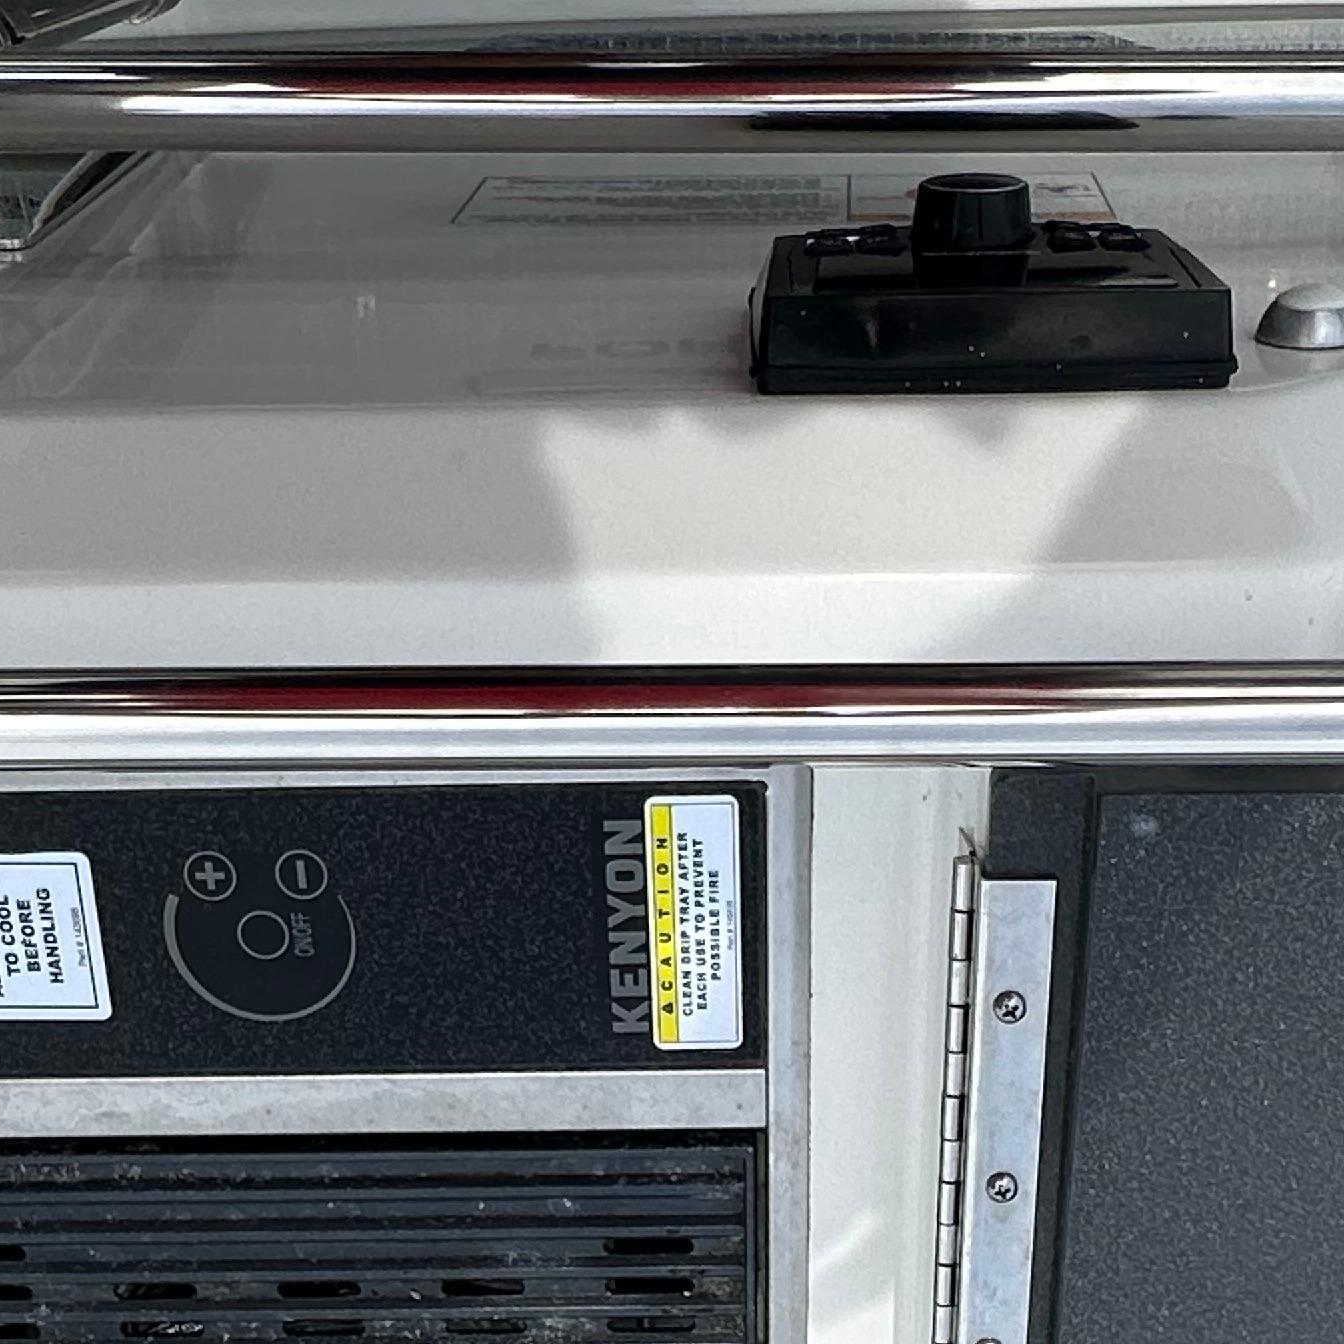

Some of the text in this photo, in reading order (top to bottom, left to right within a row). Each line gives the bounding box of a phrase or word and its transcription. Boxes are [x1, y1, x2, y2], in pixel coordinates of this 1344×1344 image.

[5, 951, 22, 977] TO
[16, 898, 42, 972] BEFORE
[36, 887, 65, 984] HANDLING
[602, 819, 650, 1034] KENYON
[655, 837, 674, 992] CAUTION
[676, 832, 694, 1017] CLEAN DRIP TRAY AFTER
[692, 838, 707, 1010] EACH USE TO PREVENT
[708, 870, 721, 981] POSSIBLE FIRE
